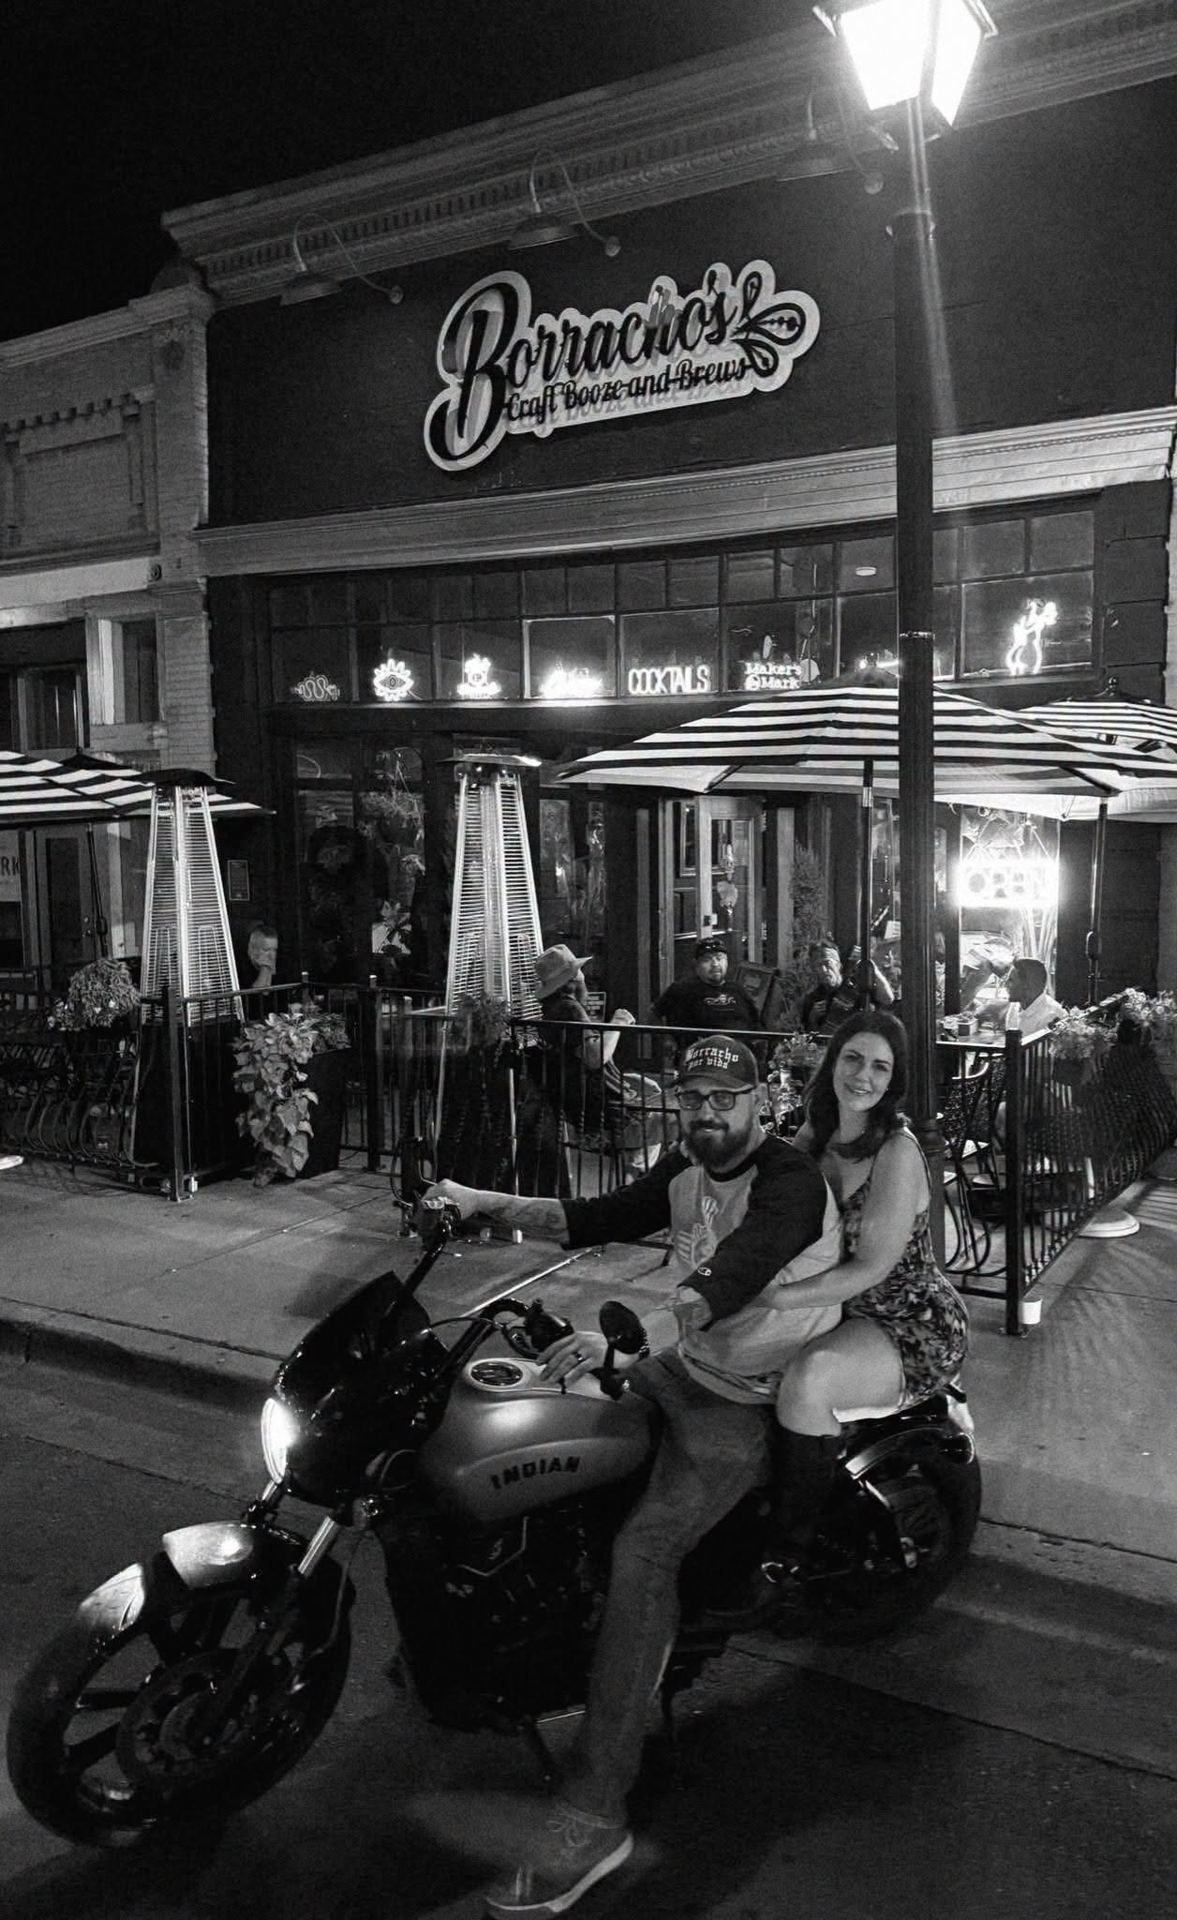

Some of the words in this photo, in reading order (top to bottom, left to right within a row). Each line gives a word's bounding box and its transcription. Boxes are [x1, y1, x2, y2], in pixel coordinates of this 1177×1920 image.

[506, 384, 560, 424] Craft
[562, 380, 623, 410] Booze
[627, 364, 672, 397] and
[676, 358, 747, 391] Brews
[761, 675, 801, 689] Mark
[490, 1456, 580, 1490] INDIAN
